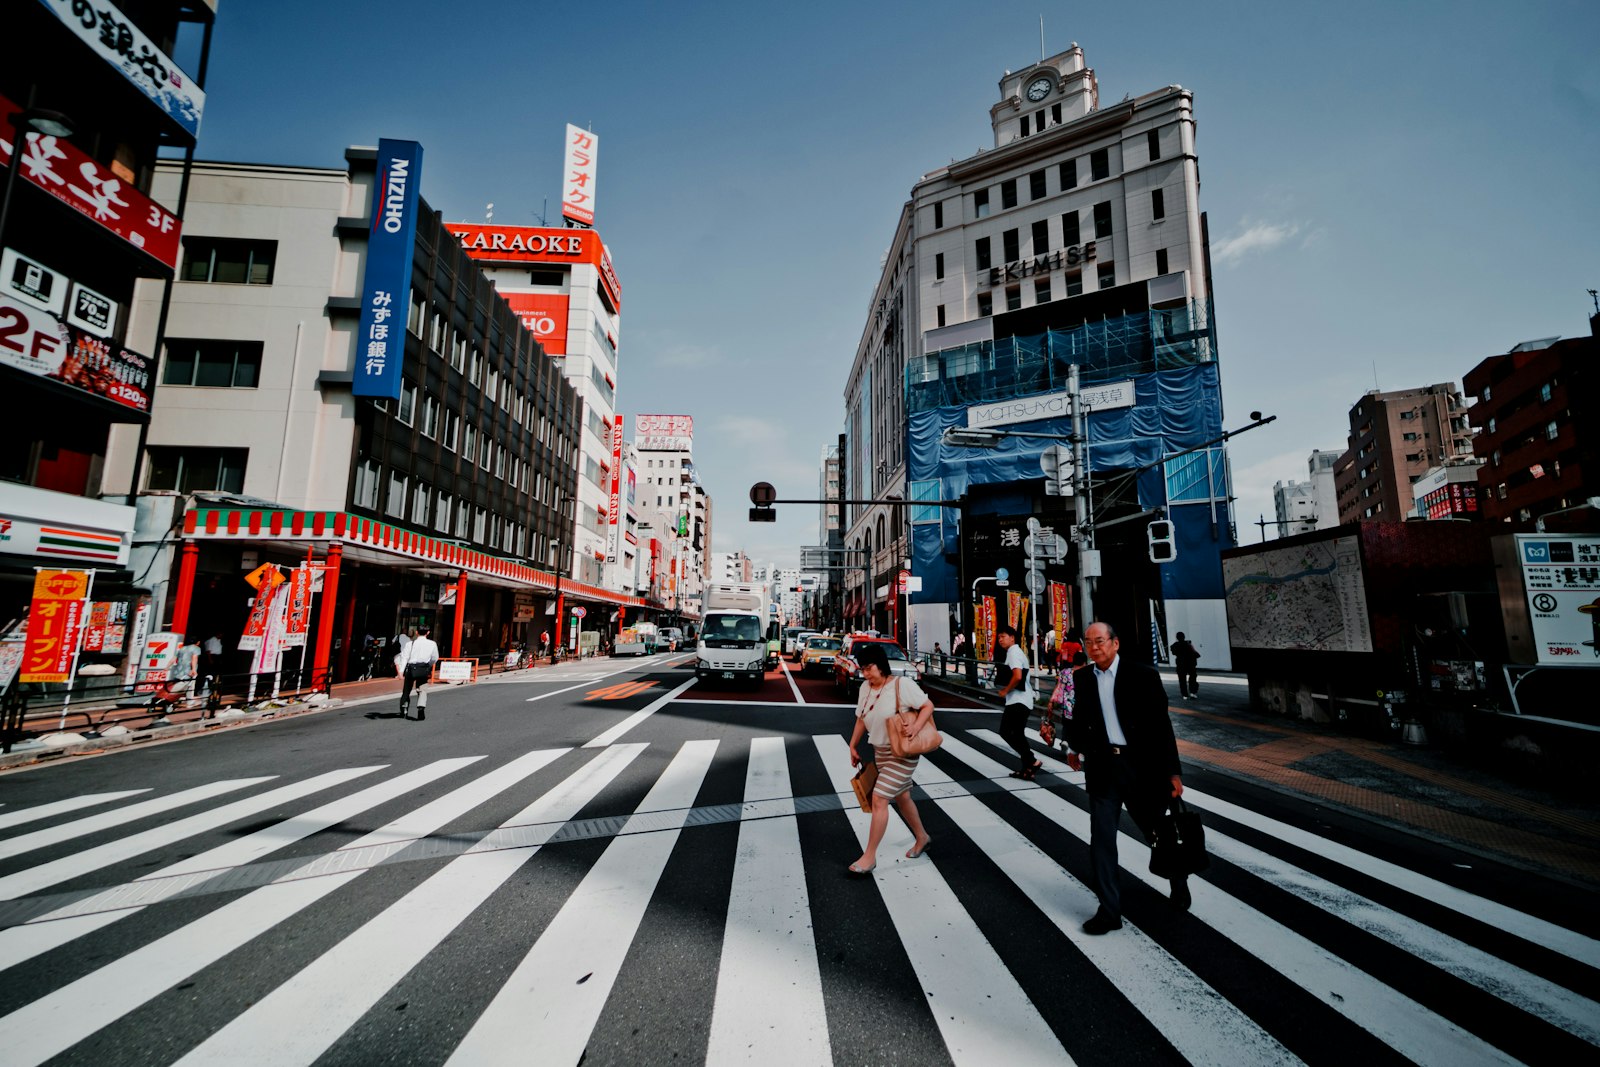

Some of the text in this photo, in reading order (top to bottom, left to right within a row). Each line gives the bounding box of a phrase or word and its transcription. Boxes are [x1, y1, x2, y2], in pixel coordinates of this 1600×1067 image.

[61, 0, 168, 89] の銀次
[568, 131, 593, 204] カラオケ
[384, 158, 409, 233] MIZUHO
[146, 204, 175, 234] 3F
[453, 231, 583, 255] KARAOKE
[989, 241, 1097, 286] EKIMISE
[513, 309, 547, 317] rtainment
[522, 317, 556, 335] HO
[0, 306, 60, 359] 2F
[366, 291, 392, 376] みずほ銀行
[613, 423, 622, 452] カラオケ
[608, 492, 618, 522] カラオケ
[41, 579, 82, 588] OPEN
[30, 600, 63, 673] オープン
[147, 641, 169, 667] 7
